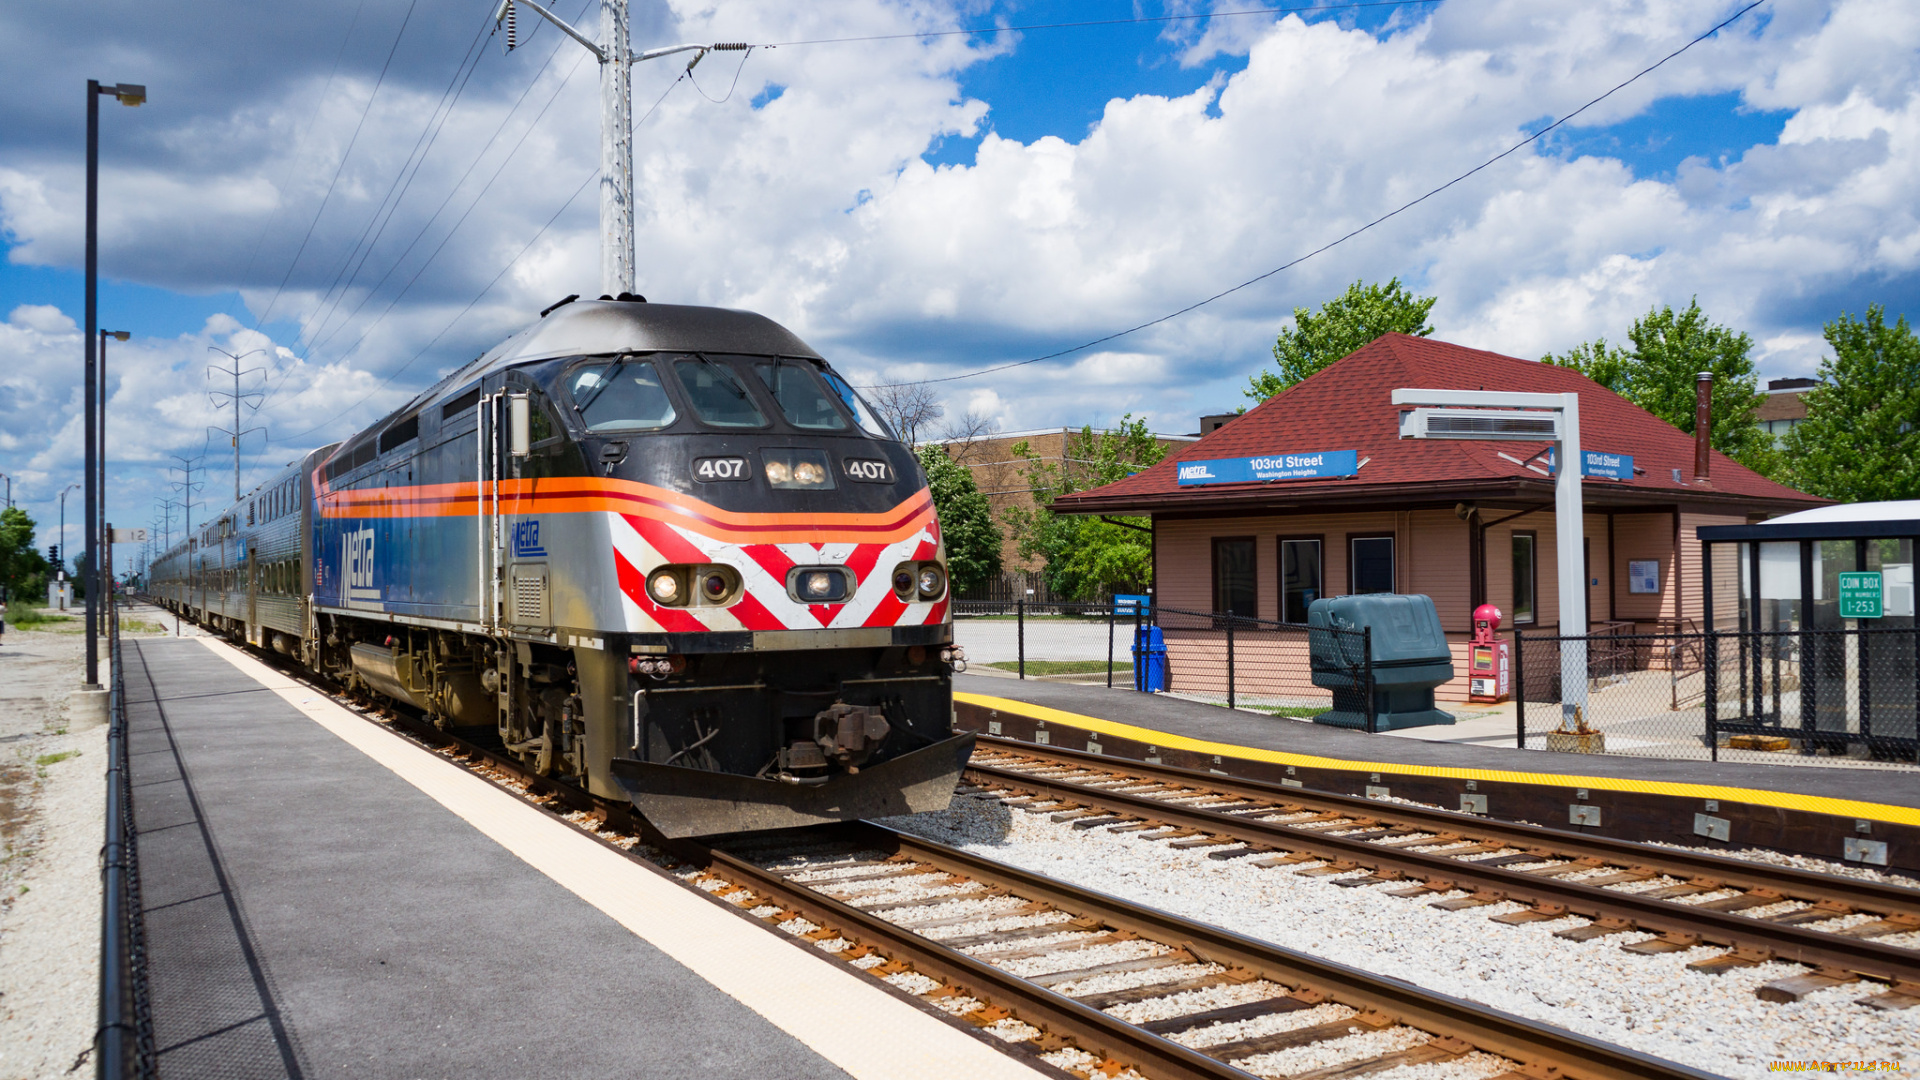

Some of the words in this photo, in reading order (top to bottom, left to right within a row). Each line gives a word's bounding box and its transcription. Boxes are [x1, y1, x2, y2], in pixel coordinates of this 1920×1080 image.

[1250, 456, 1283, 470] 103rd
[1286, 454, 1323, 468] Street
[1586, 453, 1603, 466] 103rd
[1603, 455, 1620, 468] Street
[698, 459, 744, 478] 407
[849, 461, 886, 479] 407
[1179, 465, 1213, 480] Metra
[1256, 470, 1292, 479] Washington
[1293, 469, 1317, 477] Heights
[510, 516, 545, 557] Metra
[340, 519, 379, 609] Metra
[1842, 577, 1860, 589] COIN
[1863, 577, 1879, 589] BOX
[1847, 600, 1875, 613] 1-253
